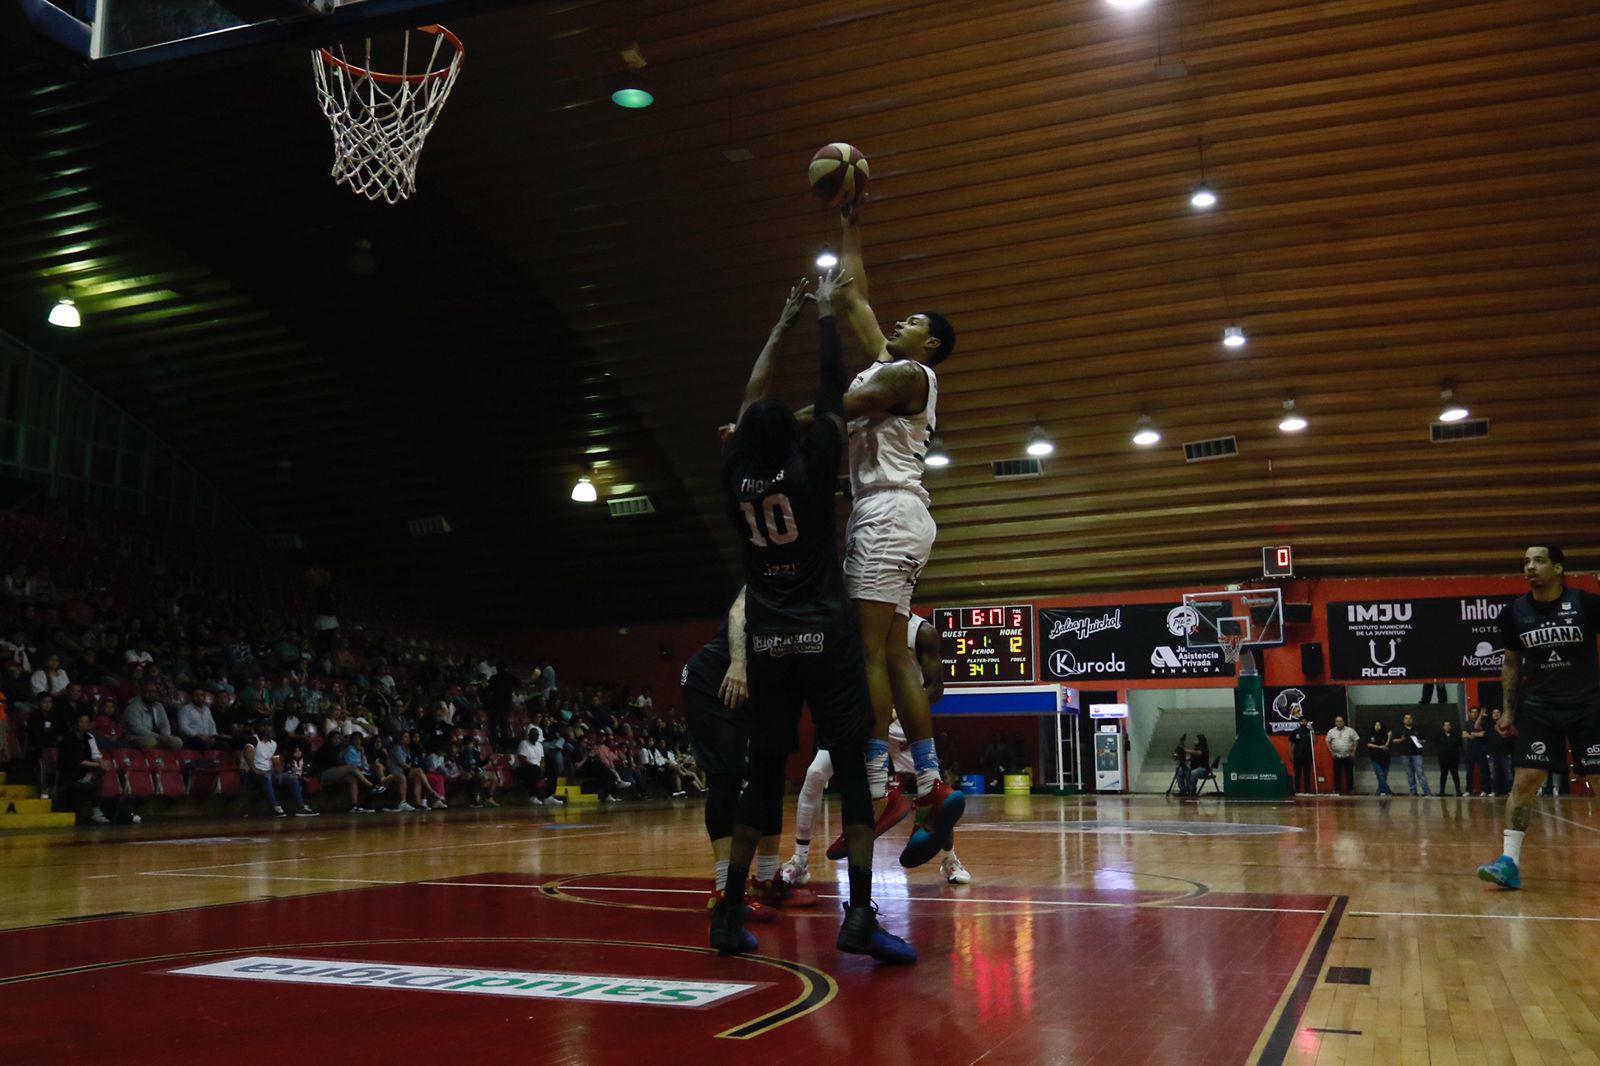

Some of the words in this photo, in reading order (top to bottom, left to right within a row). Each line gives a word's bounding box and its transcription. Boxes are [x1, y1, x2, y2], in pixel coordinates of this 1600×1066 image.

[739, 493, 799, 547] 10
[1278, 549, 1288, 566] 0
[972, 609, 1002, 625] 6:17
[1347, 603, 1413, 622] IMJU
[1013, 614, 1022, 627] 2
[1048, 617, 1080, 639] Salsa
[1076, 608, 1121, 640] Huichol
[942, 630, 968, 639] GUEST
[999, 628, 1023, 637] HOME
[1471, 626, 1502, 634] HOTE
[1520, 627, 1582, 648] TIJUANA
[956, 638, 966, 655] 3
[1009, 637, 1023, 653] 12
[1178, 651, 1219, 660] Asistencia
[969, 663, 984, 676] 34
[994, 663, 999, 675] 1
[1020, 663, 1025, 675] 1
[1055, 652, 1126, 674] Kuroda
[1182, 659, 1211, 667] Privada
[950, 664, 955, 677] 1
[1362, 667, 1407, 678] RULER
[1525, 754, 1550, 763] MEGA
